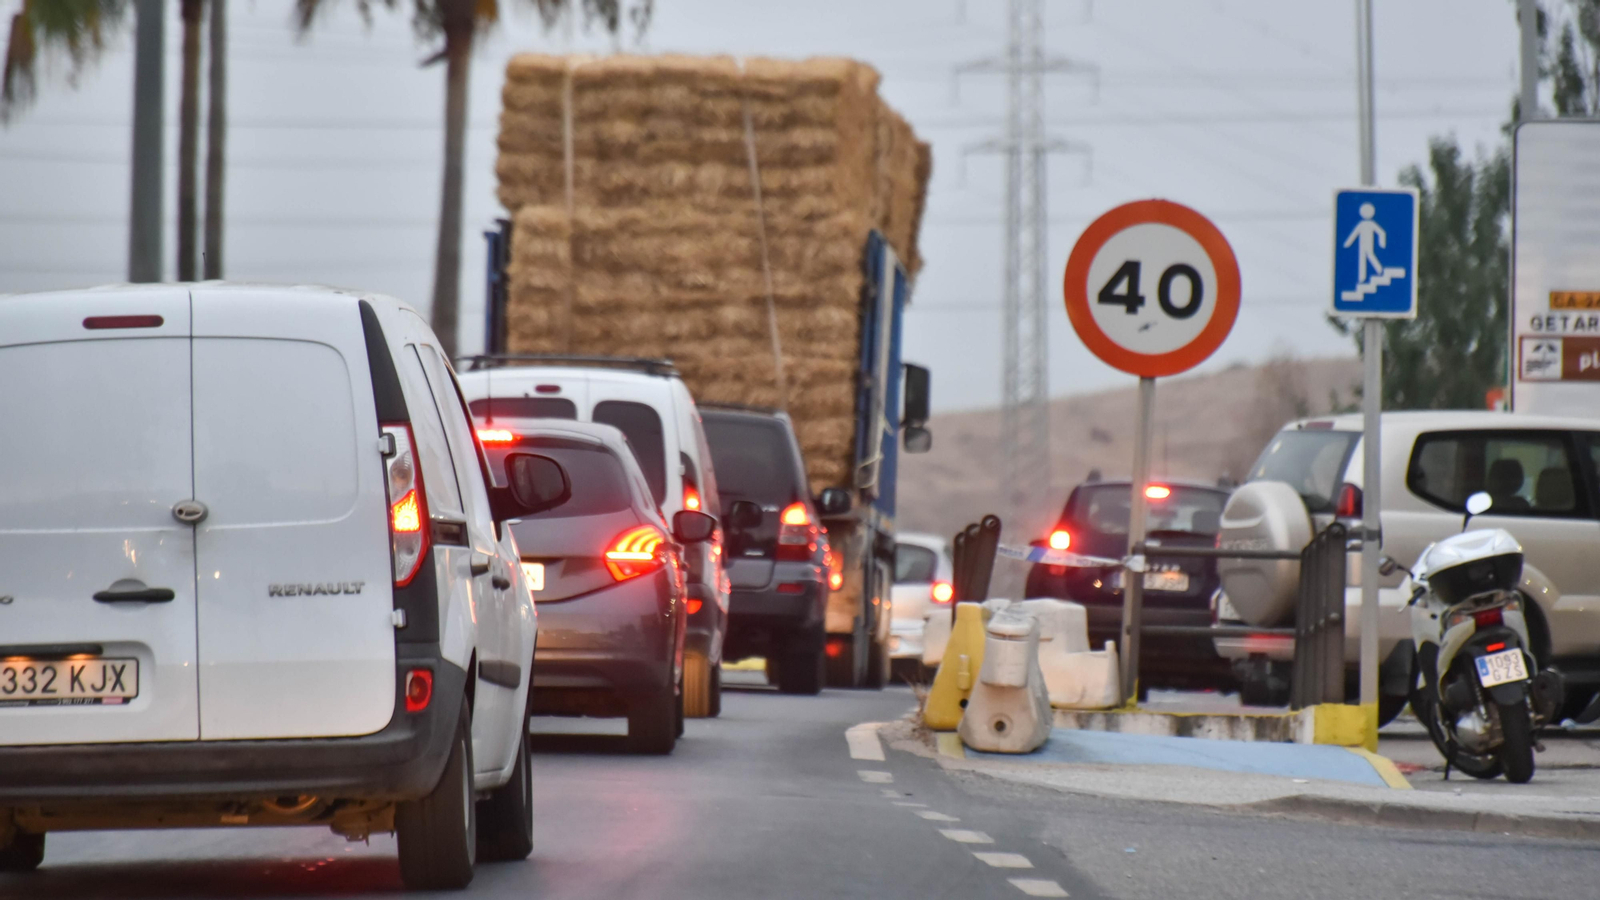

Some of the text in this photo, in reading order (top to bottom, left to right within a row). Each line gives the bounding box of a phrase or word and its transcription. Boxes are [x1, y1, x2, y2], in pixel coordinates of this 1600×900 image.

[1097, 260, 1204, 320] 40
[1530, 315, 1600, 330] GETAR
[268, 581, 366, 597] RENAULT
[1488, 652, 1519, 669] 1093
[2, 664, 127, 694] 332 KJX
[1492, 665, 1523, 681] GZS
